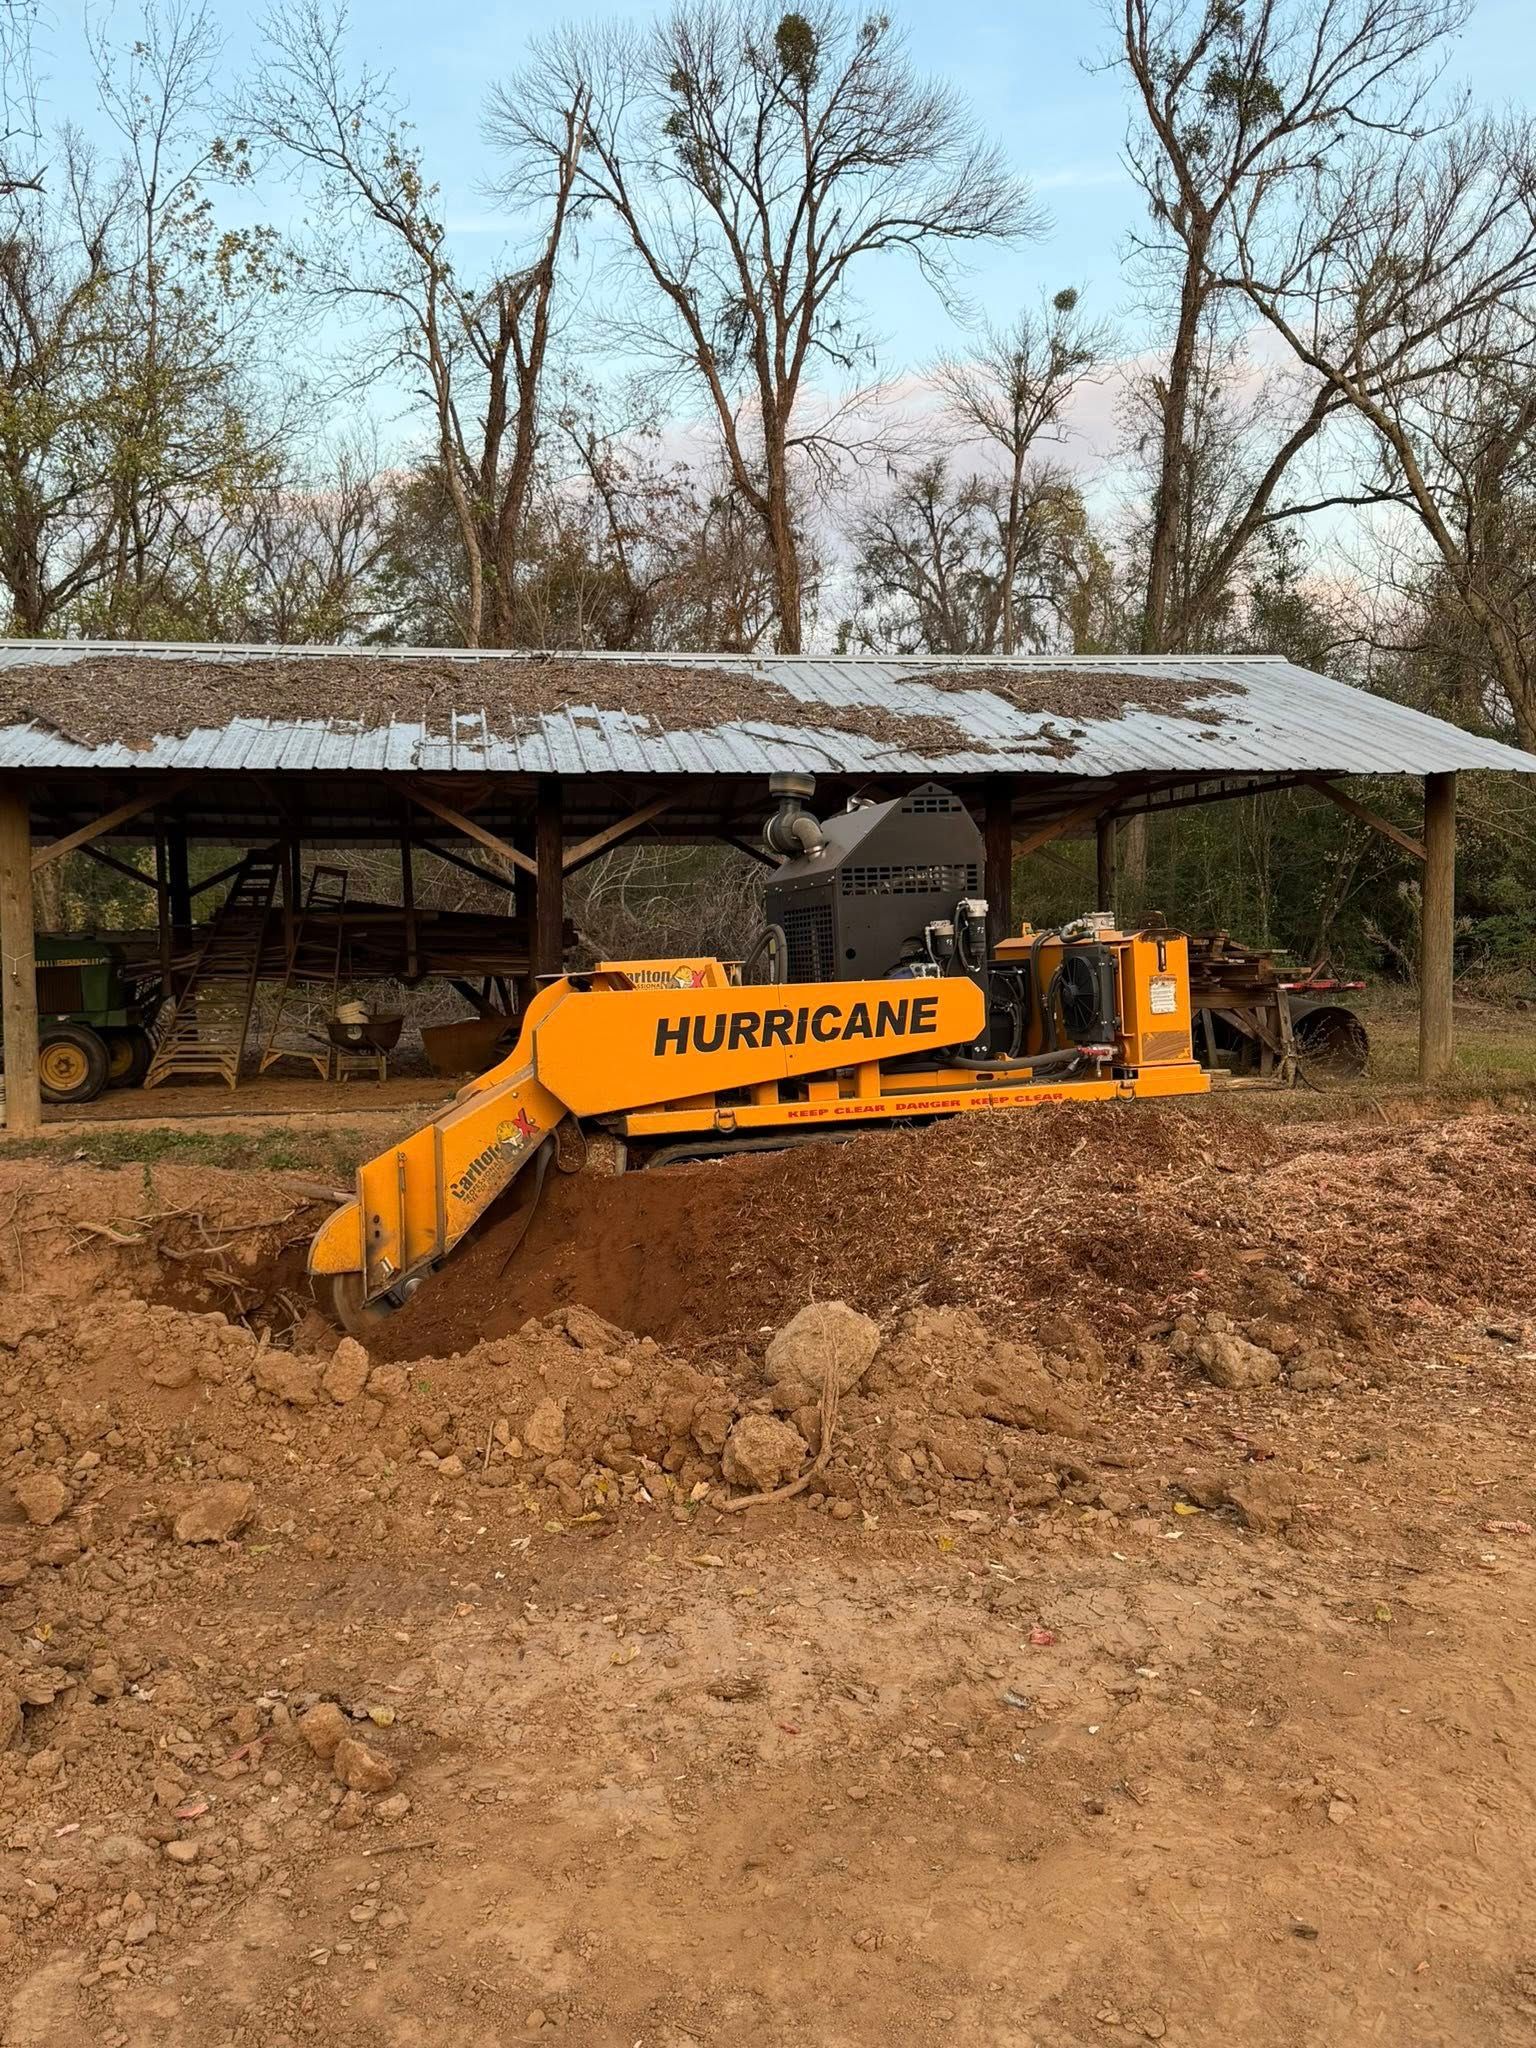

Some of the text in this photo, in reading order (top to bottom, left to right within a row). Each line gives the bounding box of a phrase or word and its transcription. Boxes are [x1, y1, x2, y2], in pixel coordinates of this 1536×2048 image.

[654, 996, 939, 1056] HURRICANE
[788, 1093, 1063, 1118] KEEP CLEAR DANGER KEEP CLEAR
